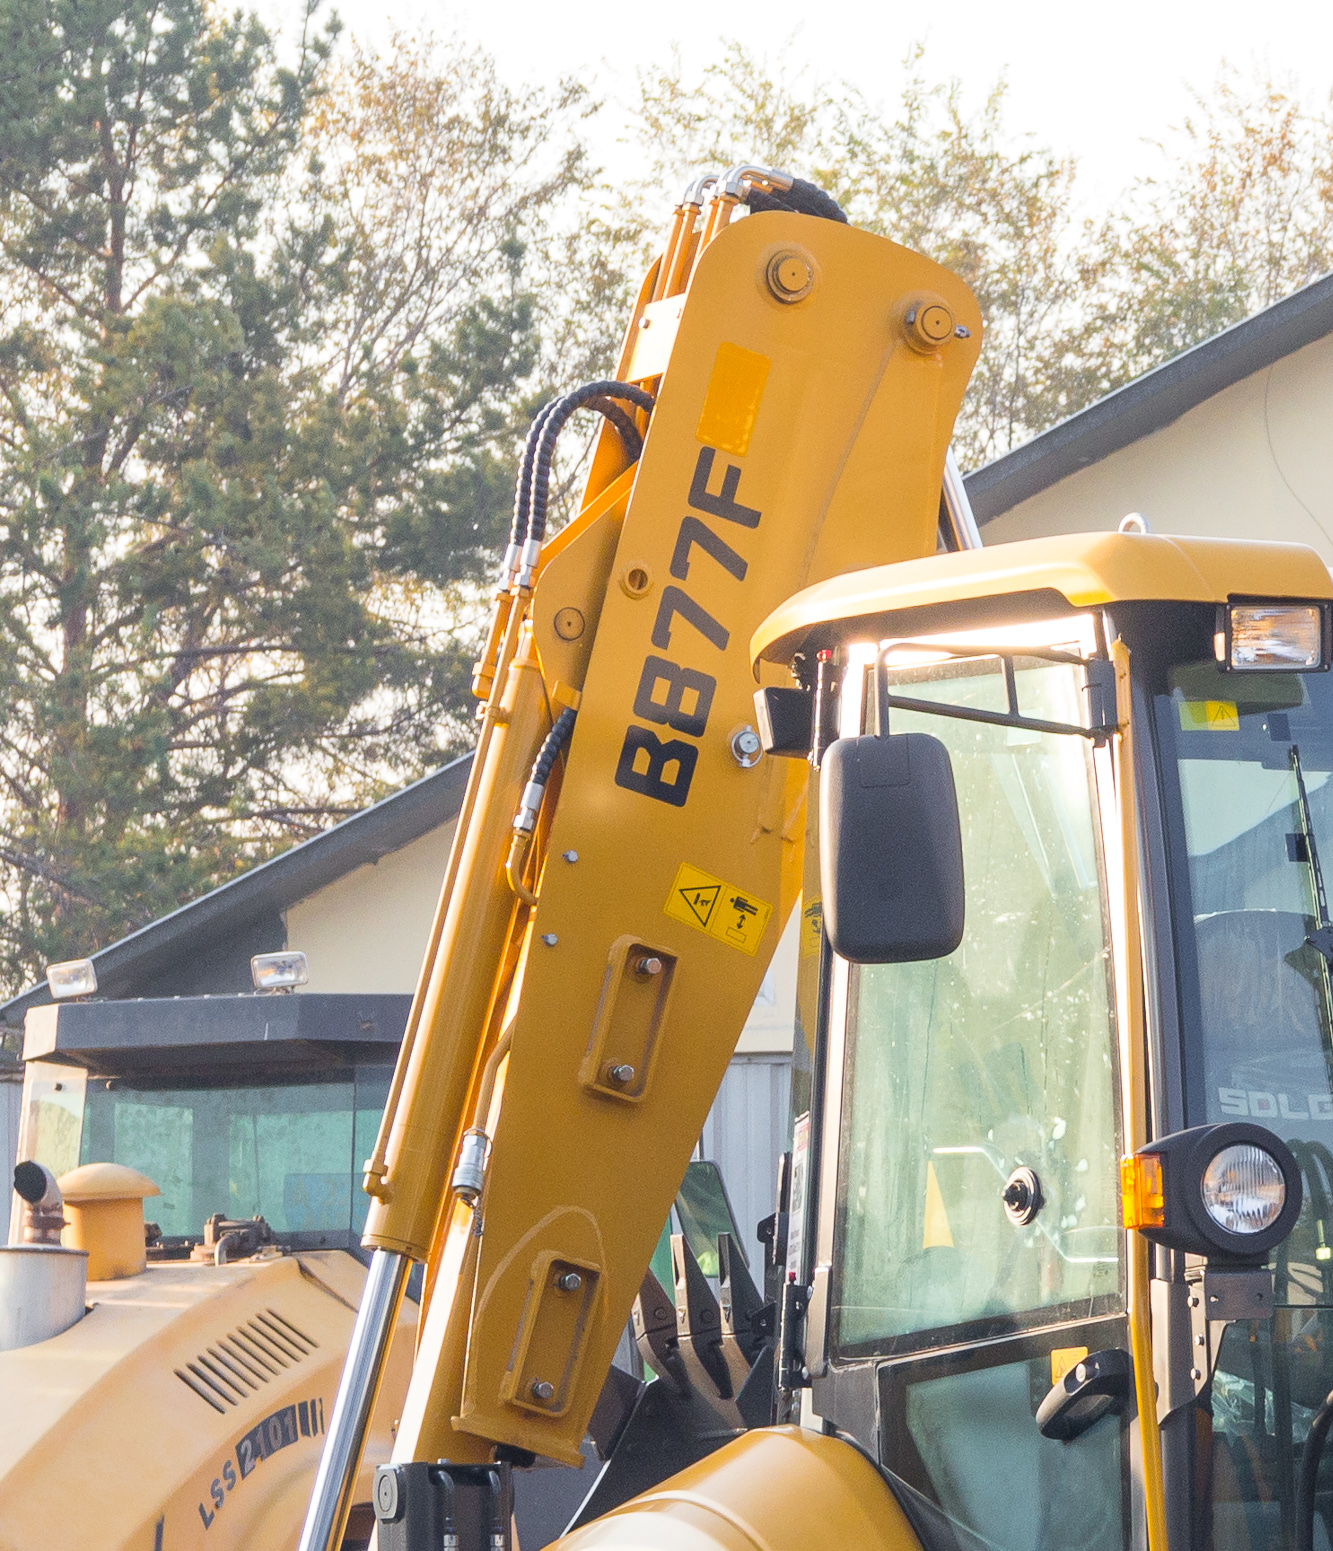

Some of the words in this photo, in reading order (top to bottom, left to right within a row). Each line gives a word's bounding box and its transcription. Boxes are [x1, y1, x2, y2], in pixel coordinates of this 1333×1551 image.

[615, 446, 762, 807] B877F
[198, 1459, 236, 1531] LSS
[240, 1408, 297, 1475] 2101
